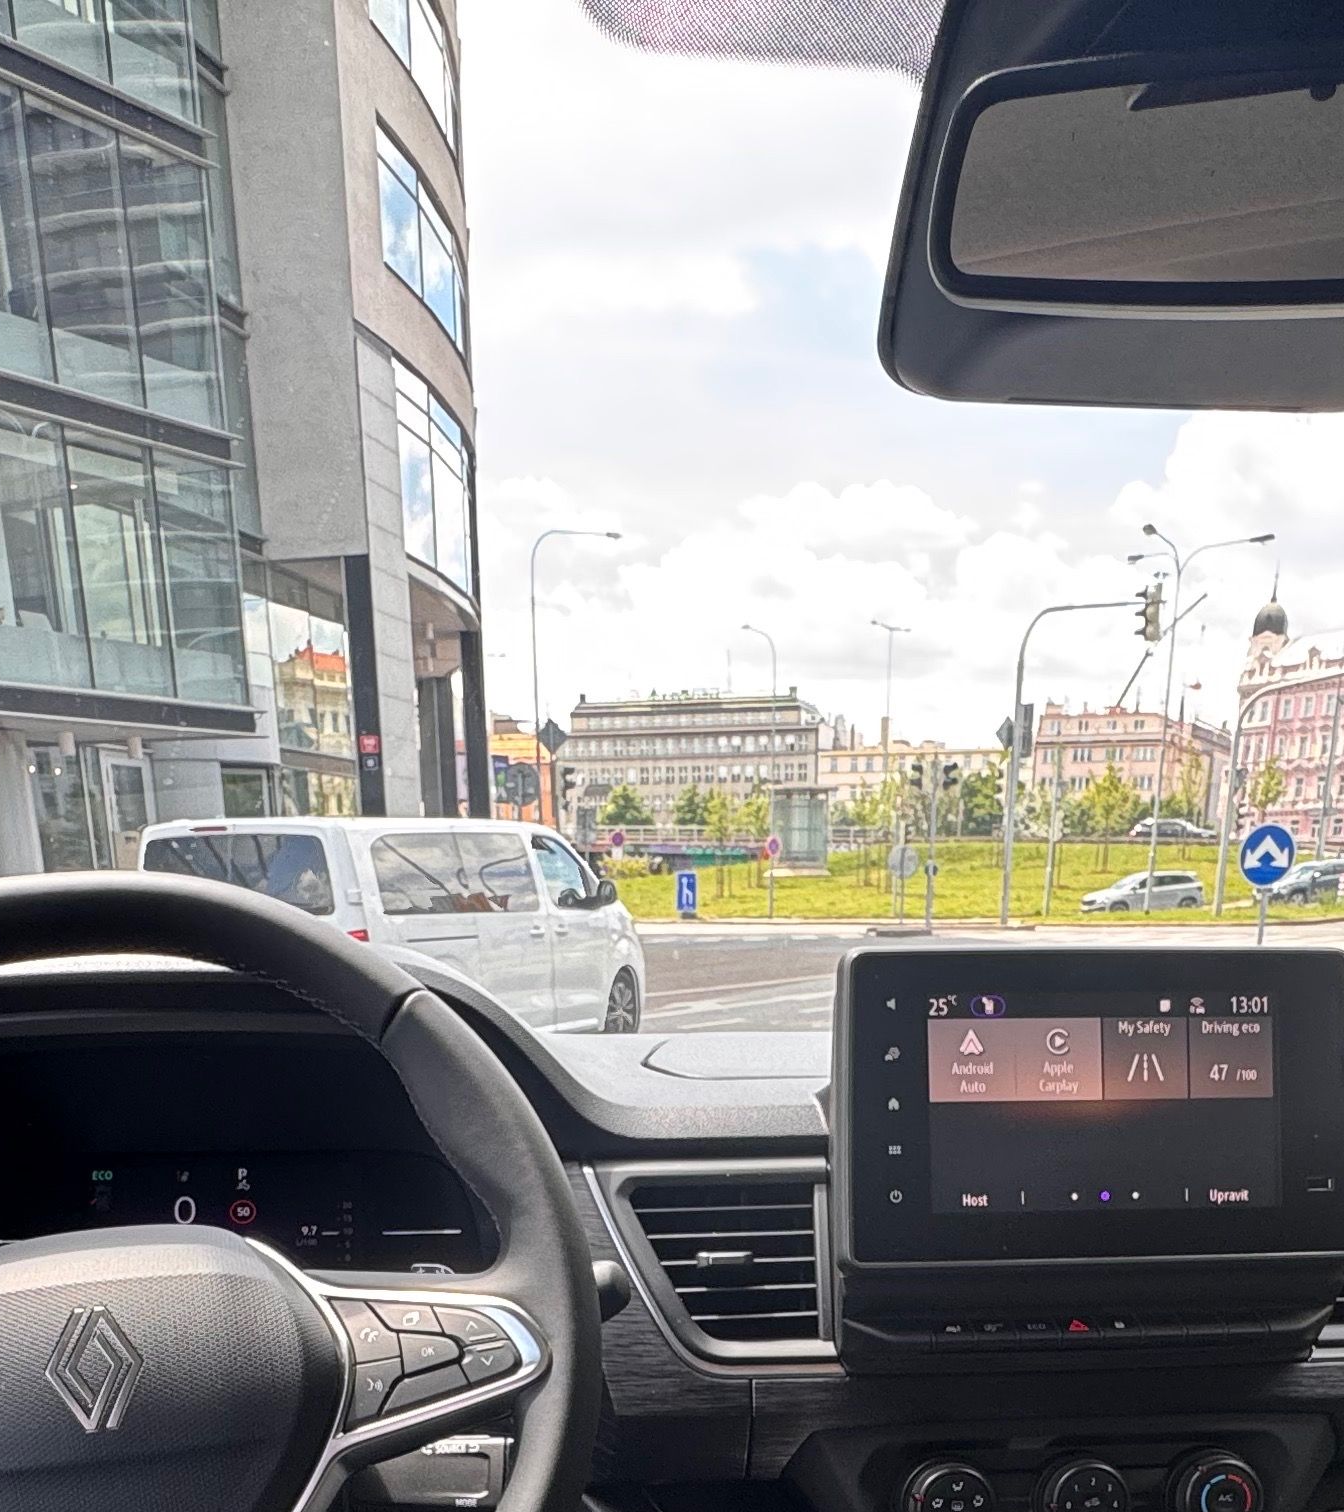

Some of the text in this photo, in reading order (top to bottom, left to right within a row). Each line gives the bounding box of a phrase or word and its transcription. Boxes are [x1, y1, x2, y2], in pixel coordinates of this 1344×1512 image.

[1230, 995, 1269, 1015] 13:01
[1118, 1020, 1171, 1037] My Safety
[1201, 1020, 1261, 1037] Driving eco
[951, 1061, 994, 1076] Android
[1042, 1060, 1074, 1077] Apple
[1209, 1063, 1257, 1081] 47 /100
[959, 1079, 986, 1094] Auto
[1039, 1078, 1080, 1095] Carplay
[91, 1170, 114, 1181] ECO
[237, 1167, 248, 1181] P
[962, 1193, 989, 1208] Host
[1209, 1187, 1250, 1205] Upravit
[174, 1195, 197, 1225] 0
[236, 1206, 251, 1217] 50
[301, 1224, 319, 1237] 9.7
[421, 1346, 435, 1358] OK
